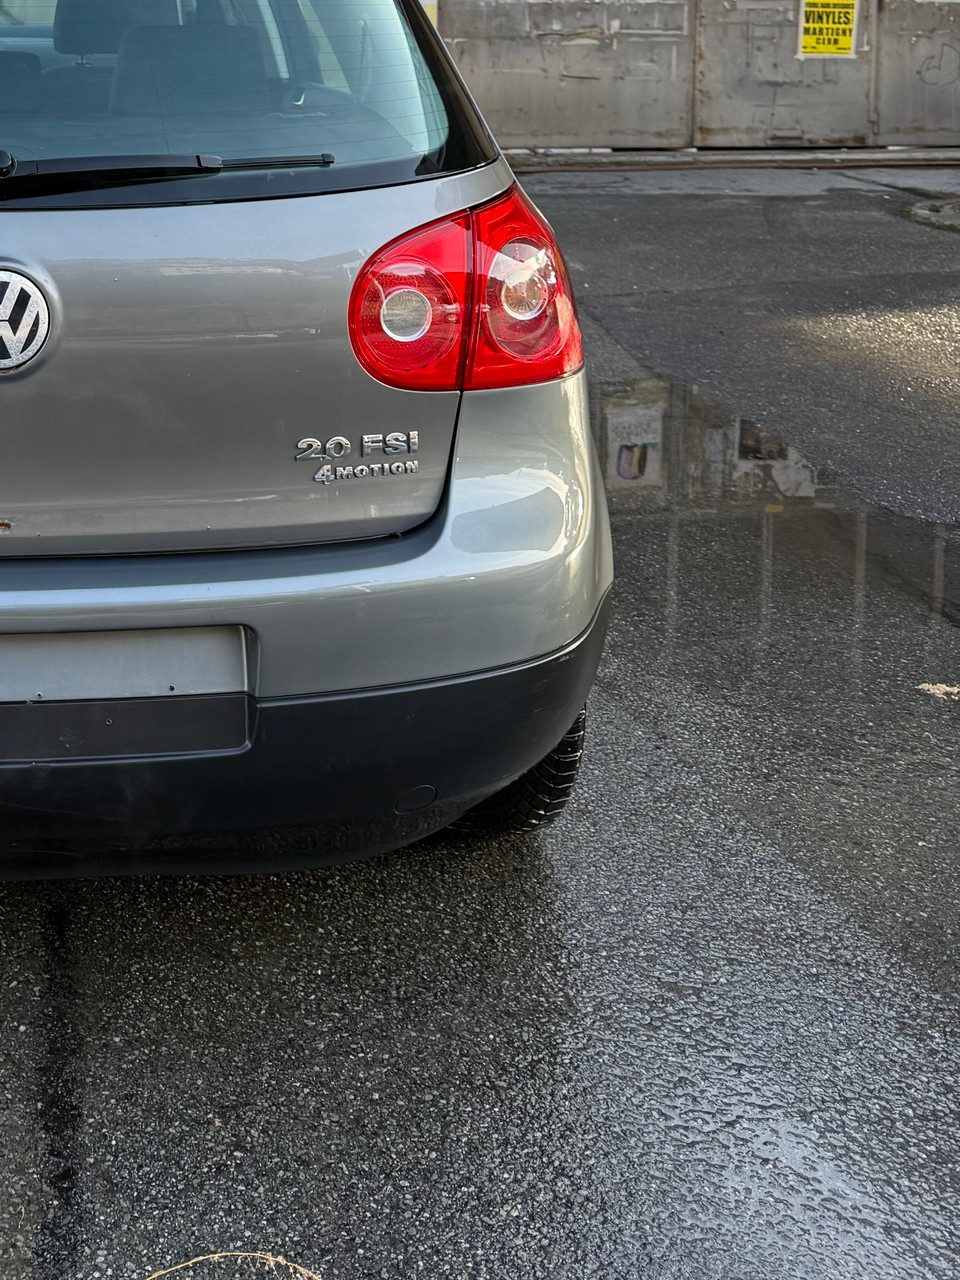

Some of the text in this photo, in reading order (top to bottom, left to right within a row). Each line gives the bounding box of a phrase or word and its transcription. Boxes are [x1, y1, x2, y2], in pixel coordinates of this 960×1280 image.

[804, 10, 851, 25] VINYLES
[803, 26, 853, 37] MARTIGNY
[361, 430, 419, 458] FSI
[314, 460, 419, 484] 4MOTION
